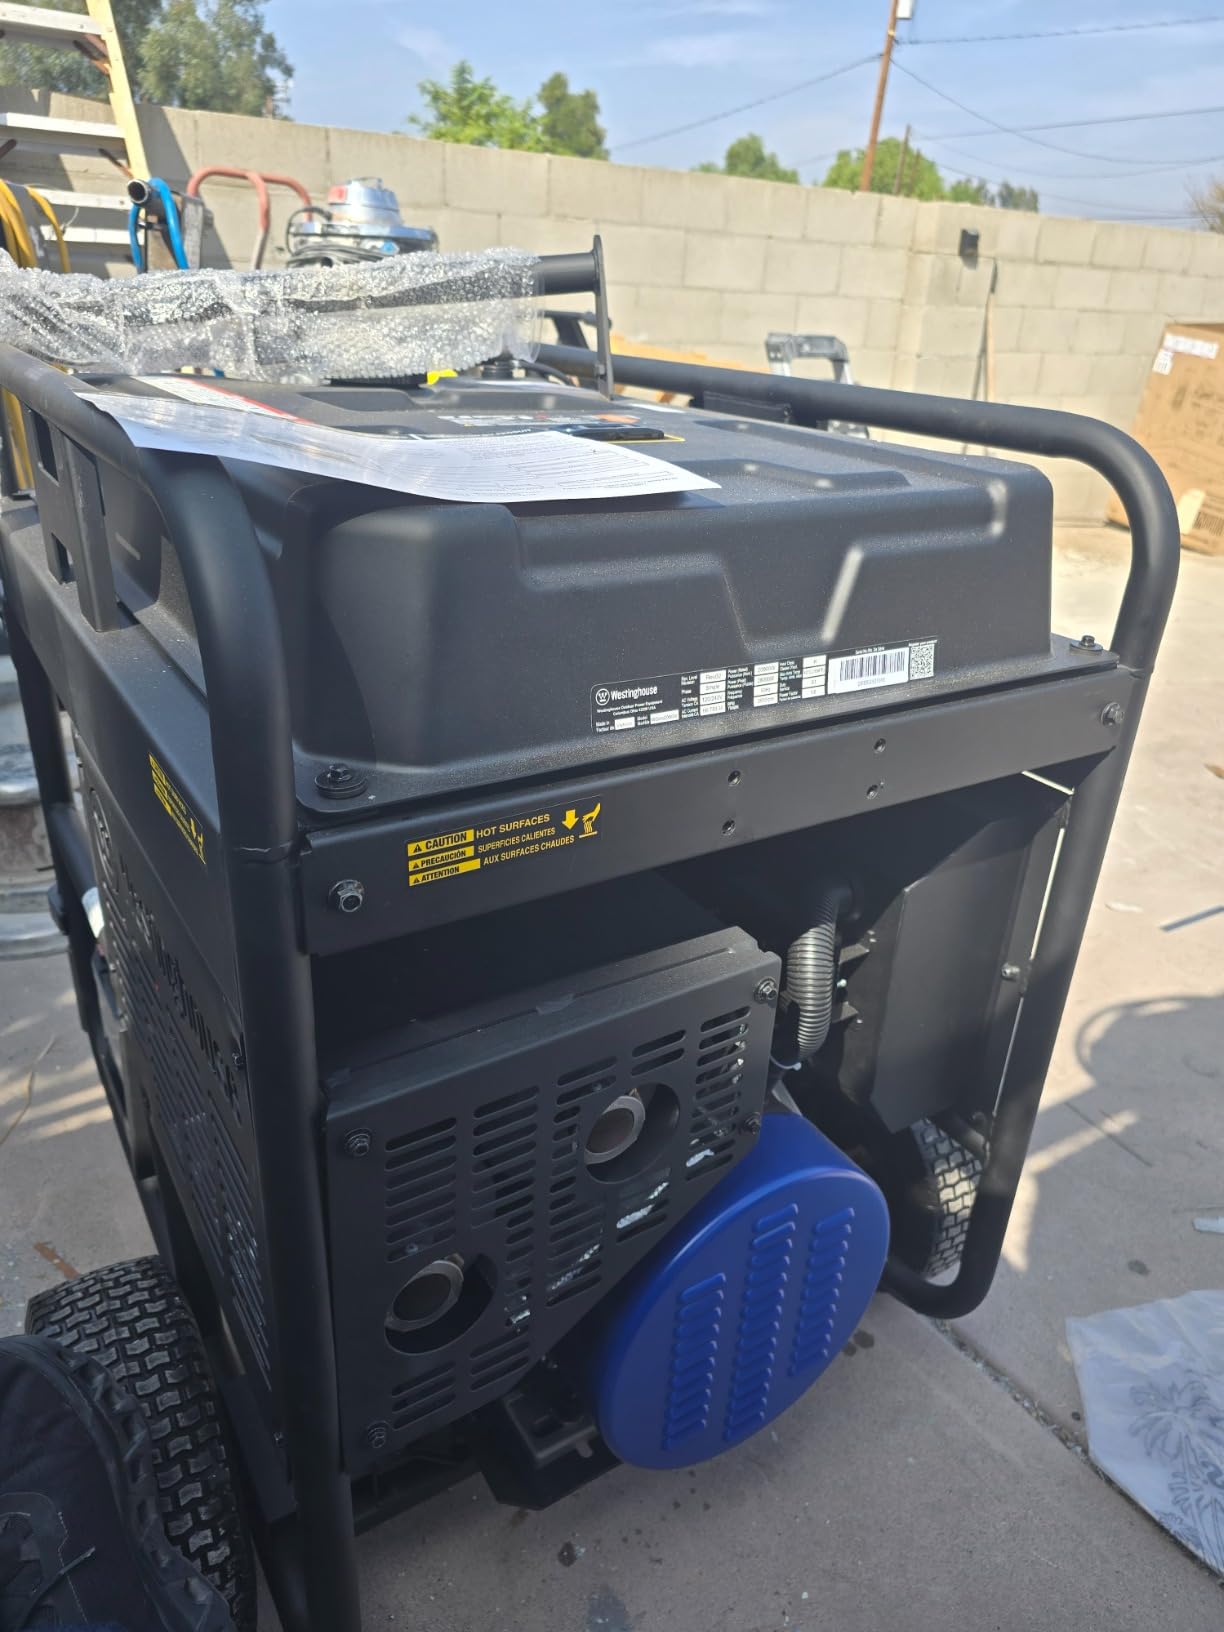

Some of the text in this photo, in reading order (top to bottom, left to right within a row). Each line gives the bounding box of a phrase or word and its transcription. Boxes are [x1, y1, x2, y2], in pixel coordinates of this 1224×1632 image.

[611, 686, 658, 701] Westinghouse
[420, 827, 556, 868] PRECAUCIÓN SUPERFICIES CALIENTES
[425, 813, 551, 850] CAUTION HOT SURFACES
[421, 835, 575, 883] ATTENTION AUX SURFACES CHAUDES
